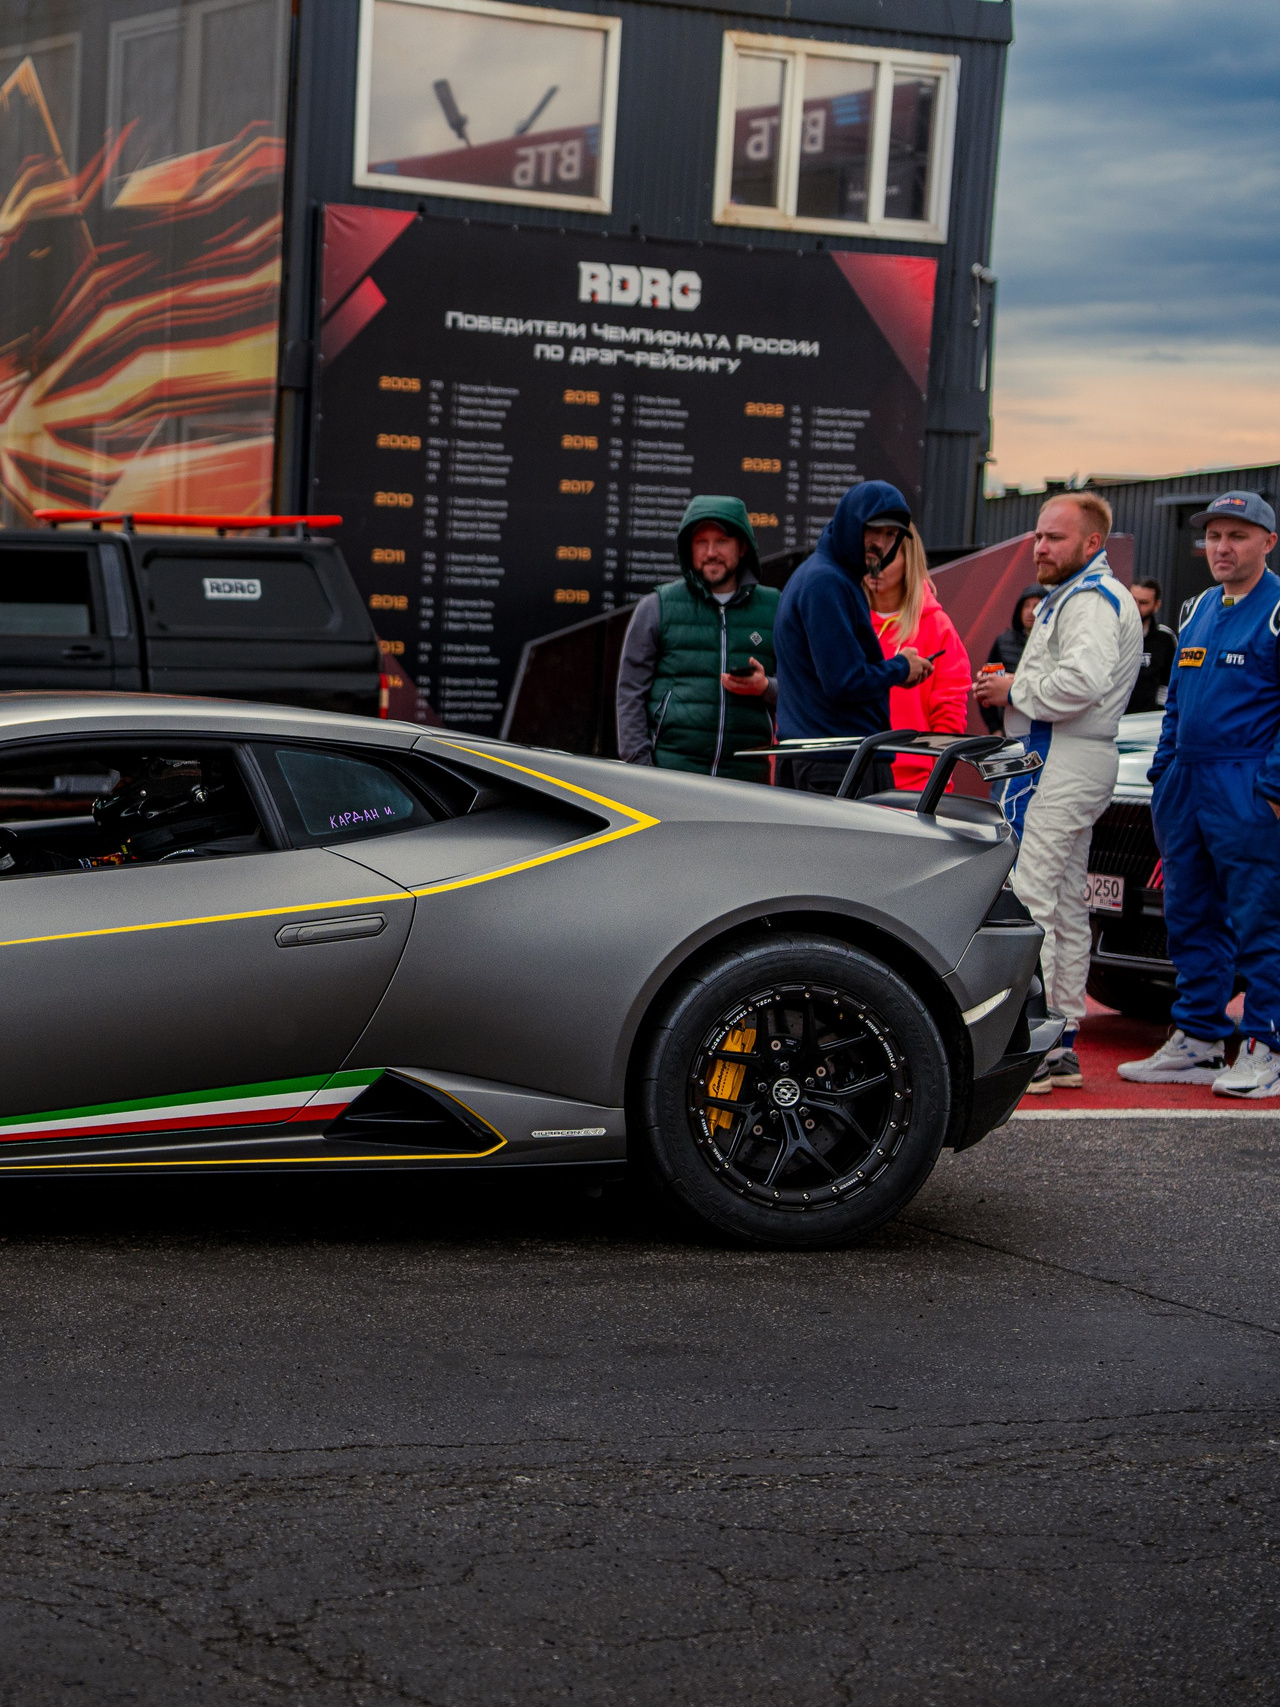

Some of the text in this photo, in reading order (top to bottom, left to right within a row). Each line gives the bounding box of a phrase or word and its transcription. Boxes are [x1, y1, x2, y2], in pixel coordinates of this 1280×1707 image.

[578, 261, 702, 311] RDRC
[749, 512, 779, 528] 024
[210, 582, 257, 595] RDRC
[379, 639, 405, 656] 013
[1225, 653, 1245, 666] ВТБ
[329, 808, 380, 829] КАРДАН
[1095, 878, 1119, 898] 250
